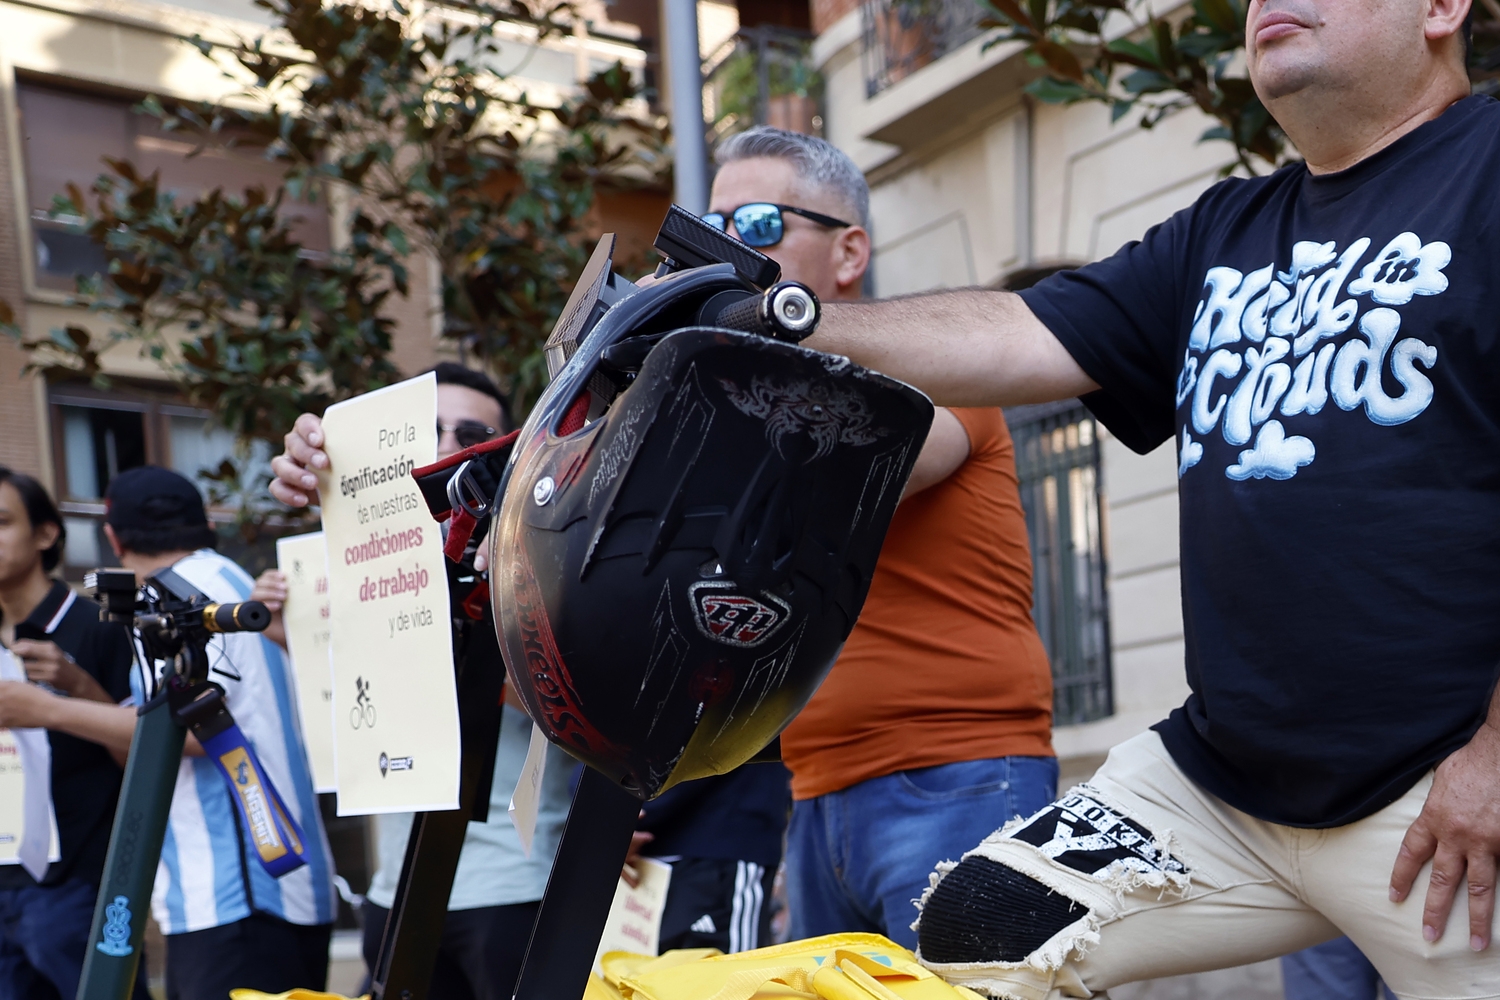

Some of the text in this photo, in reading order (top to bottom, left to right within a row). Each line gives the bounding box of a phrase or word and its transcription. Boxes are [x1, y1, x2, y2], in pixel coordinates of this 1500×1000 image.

[379, 423, 416, 450] Por la
[340, 455, 415, 498] dignificación
[357, 492, 419, 525] de nuestras
[345, 526, 423, 565] condiciones
[359, 576, 377, 602] de
[379, 563, 428, 599] trabajo
[388, 606, 433, 638] y de vida
